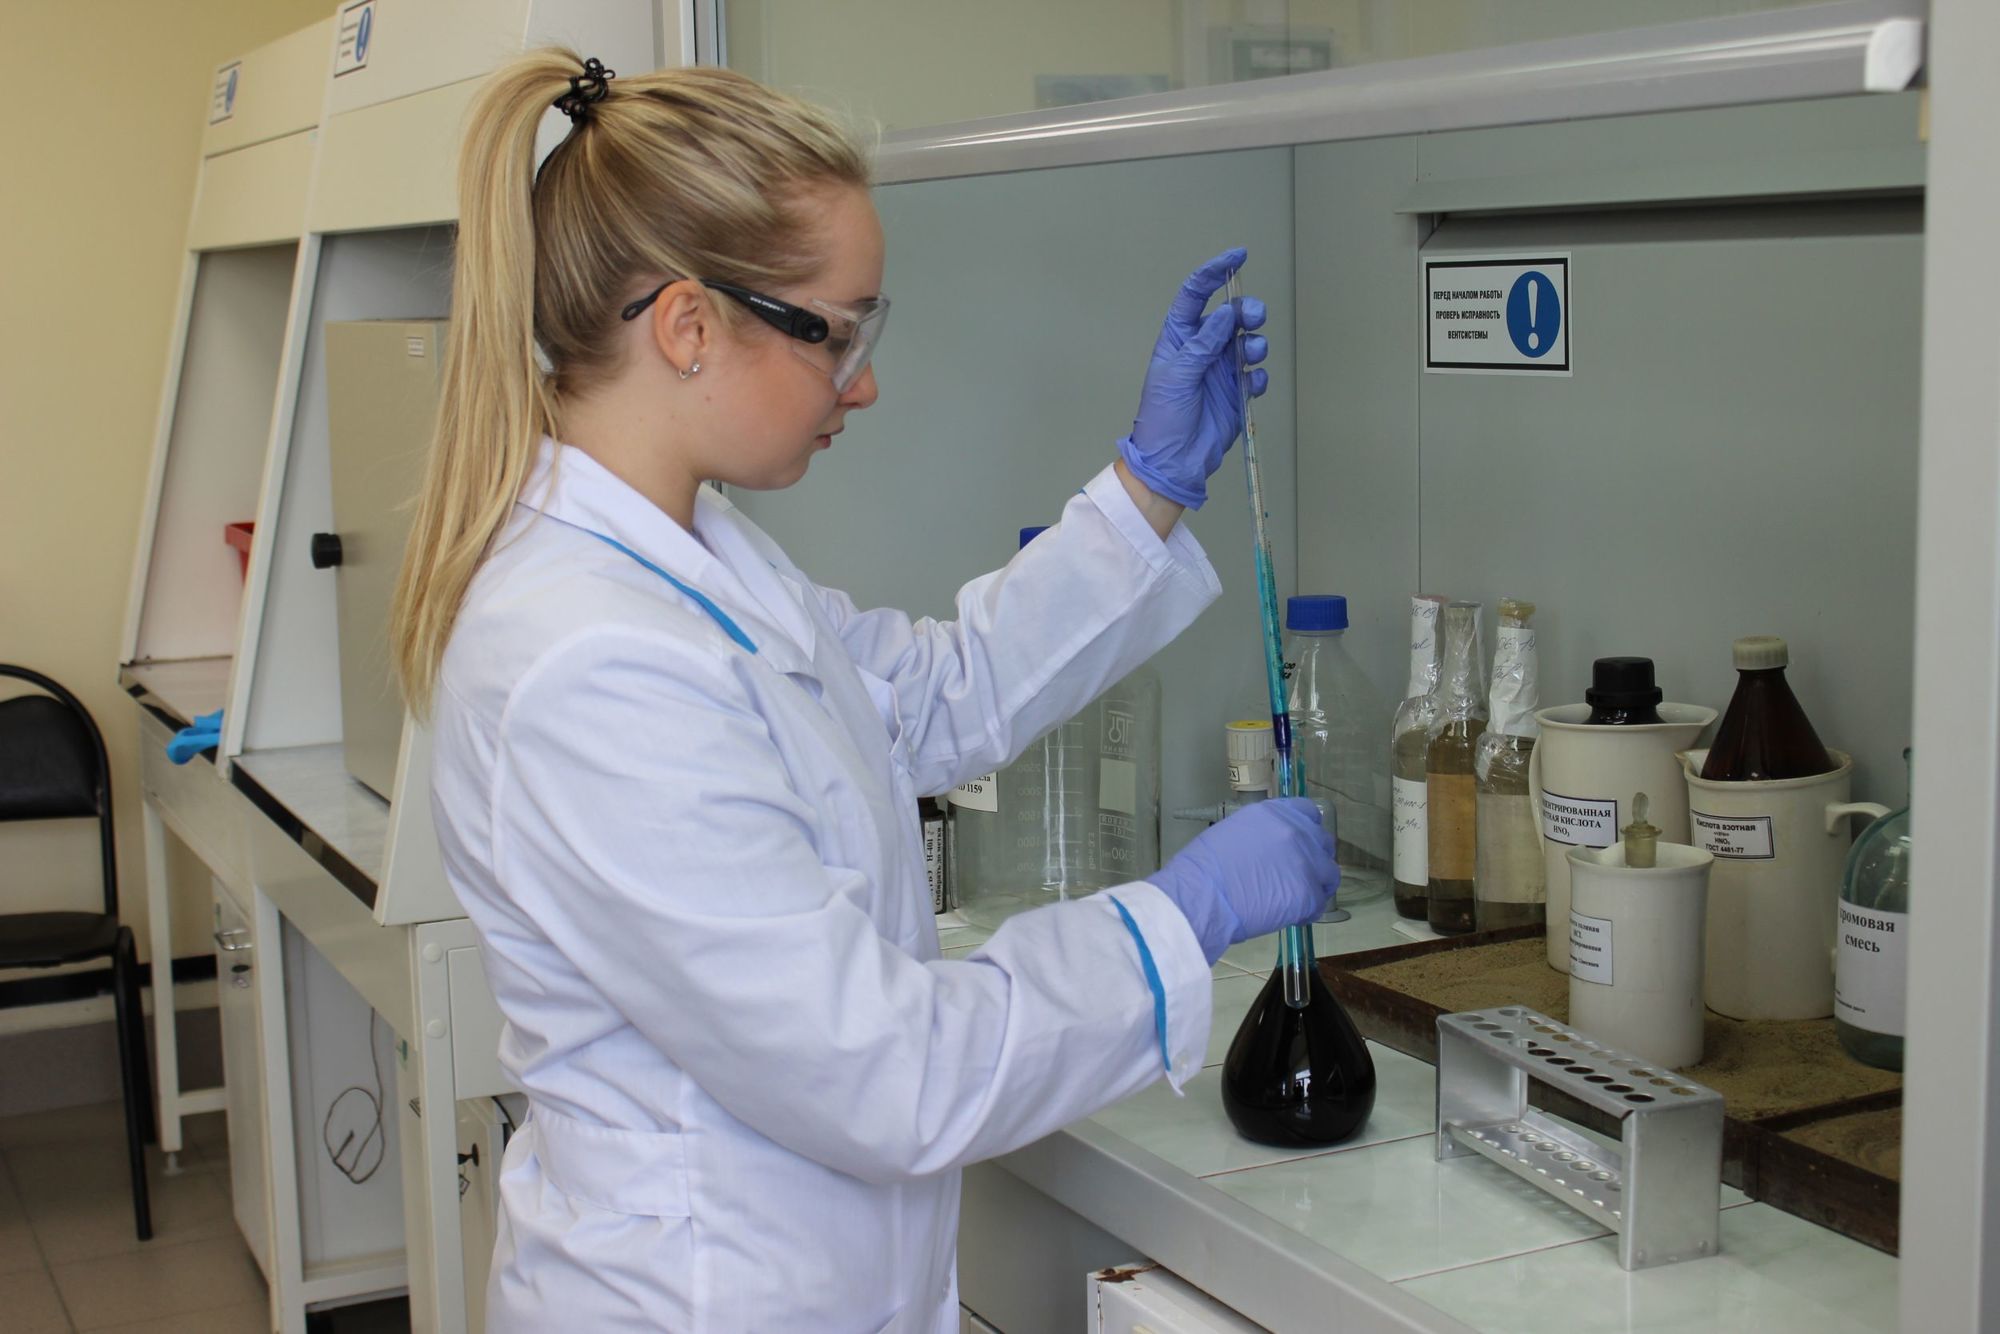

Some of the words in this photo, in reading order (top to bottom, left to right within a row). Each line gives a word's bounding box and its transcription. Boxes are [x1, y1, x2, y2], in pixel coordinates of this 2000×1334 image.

[1433, 291, 1451, 301] ПЕРЕД
[1452, 291, 1479, 300] НАЧАЛОМ
[1480, 290, 1503, 299] РАБОТЫ
[1435, 311, 1460, 320] ПРОВЕРЬ
[1461, 311, 1501, 320] ИСПРАВНОСТЬ
[1447, 330, 1489, 340] ВЕНТСИСТЕМЫ
[967, 783, 983, 794] 1159
[1560, 816, 1602, 829] КИСЛОТА
[1695, 818, 1721, 830] Кислота
[1722, 824, 1757, 832] азотная
[1705, 843, 1719, 853] ГОСТ
[1839, 909, 1895, 932] ромовая
[1845, 933, 1881, 953] смесь
